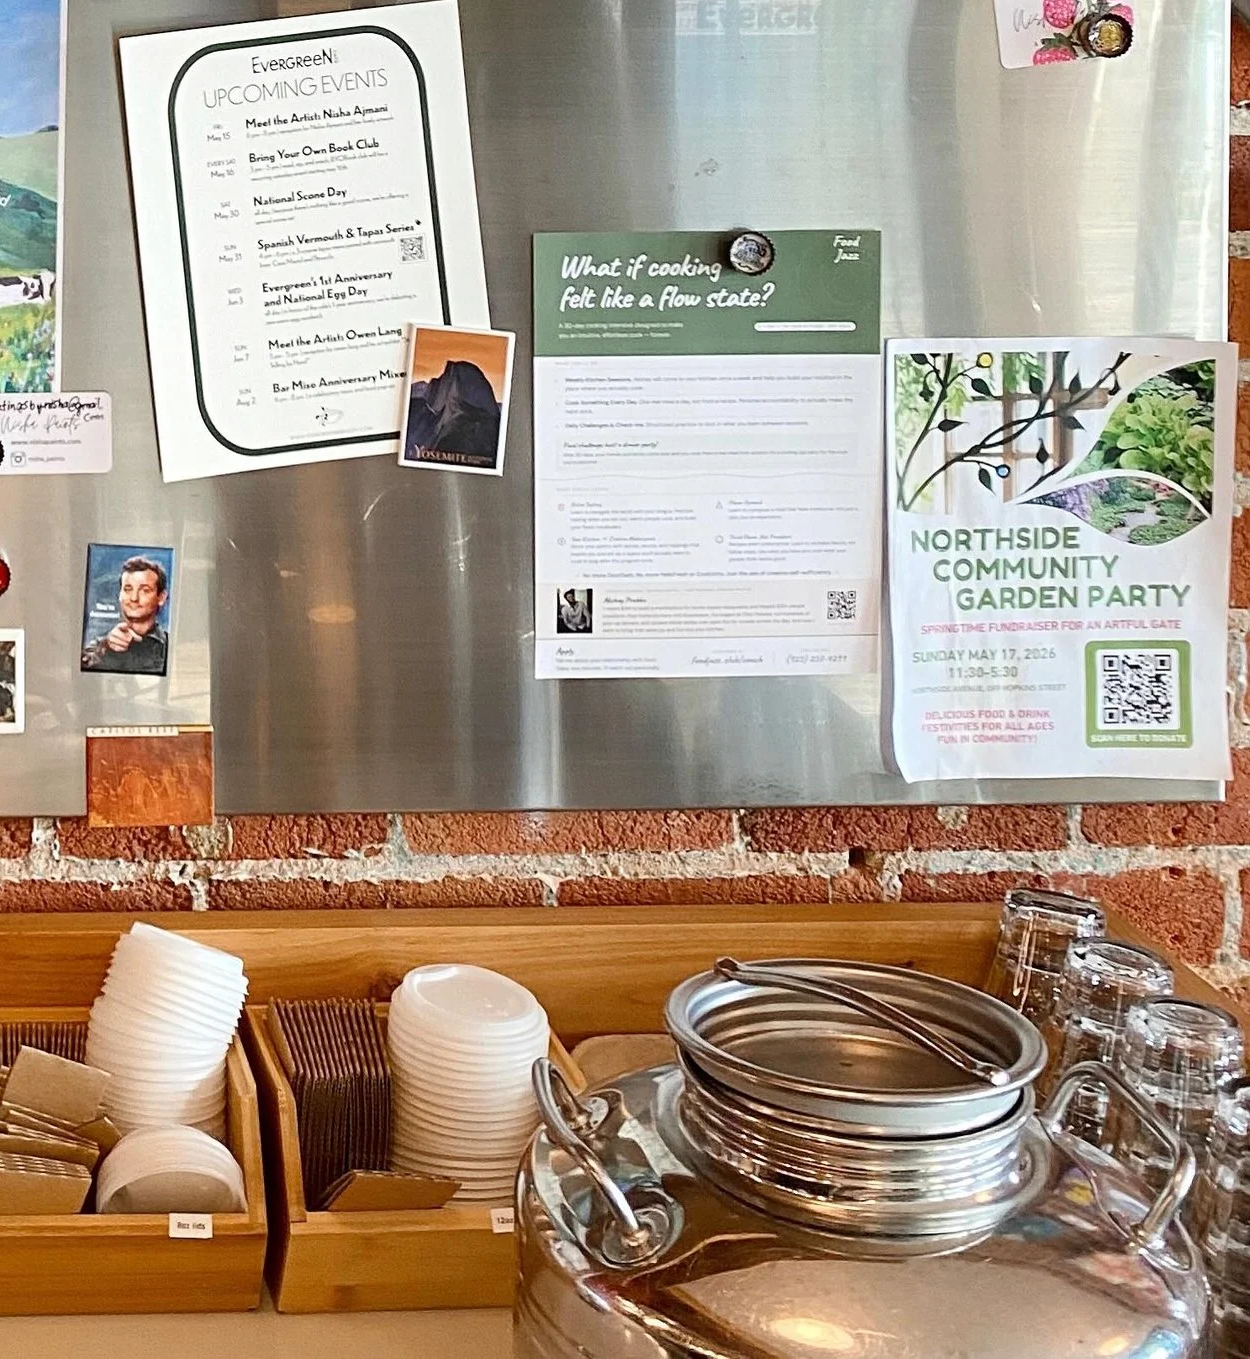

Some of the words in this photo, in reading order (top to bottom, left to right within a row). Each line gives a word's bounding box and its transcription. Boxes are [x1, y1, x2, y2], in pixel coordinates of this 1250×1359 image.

[204, 78, 317, 109] UPCOMING
[321, 69, 388, 94] EVENTS
[249, 153, 276, 163] Bring
[278, 149, 300, 160] Your
[302, 146, 327, 156] Own
[329, 141, 354, 153] Book
[356, 138, 379, 150] Club
[253, 192, 296, 207] National
[297, 190, 325, 201] Scone
[327, 187, 347, 198] Day
[833, 235, 860, 247] Food
[562, 255, 621, 280] What
[627, 255, 646, 280] if
[649, 255, 721, 281] cooking
[264, 297, 281, 307] and
[283, 290, 325, 305] National
[327, 290, 347, 301] Egg
[348, 286, 368, 297] Day
[560, 285, 596, 311] felt
[600, 284, 633, 308] like
[639, 296, 654, 308] a
[659, 284, 701, 311] flow
[706, 283, 776, 308] state?
[912, 527, 1080, 552] NORTHSIDE
[933, 555, 1119, 581] COMMUNITY
[956, 587, 1077, 610] GARDEN
[1088, 584, 1191, 607] PARTY
[989, 621, 1059, 632] FUNDRAISER
[1062, 621, 1083, 630] FOR
[1087, 620, 1102, 629] AN
[1105, 620, 1148, 629] ARTFUL
[1151, 619, 1181, 629] GATE
[912, 650, 965, 663] SUNDAY
[968, 650, 996, 660] MAY
[1000, 650, 1021, 662] 17,
[1024, 649, 1056, 660] 2026
[948, 666, 1018, 679] 11:30-5:30
